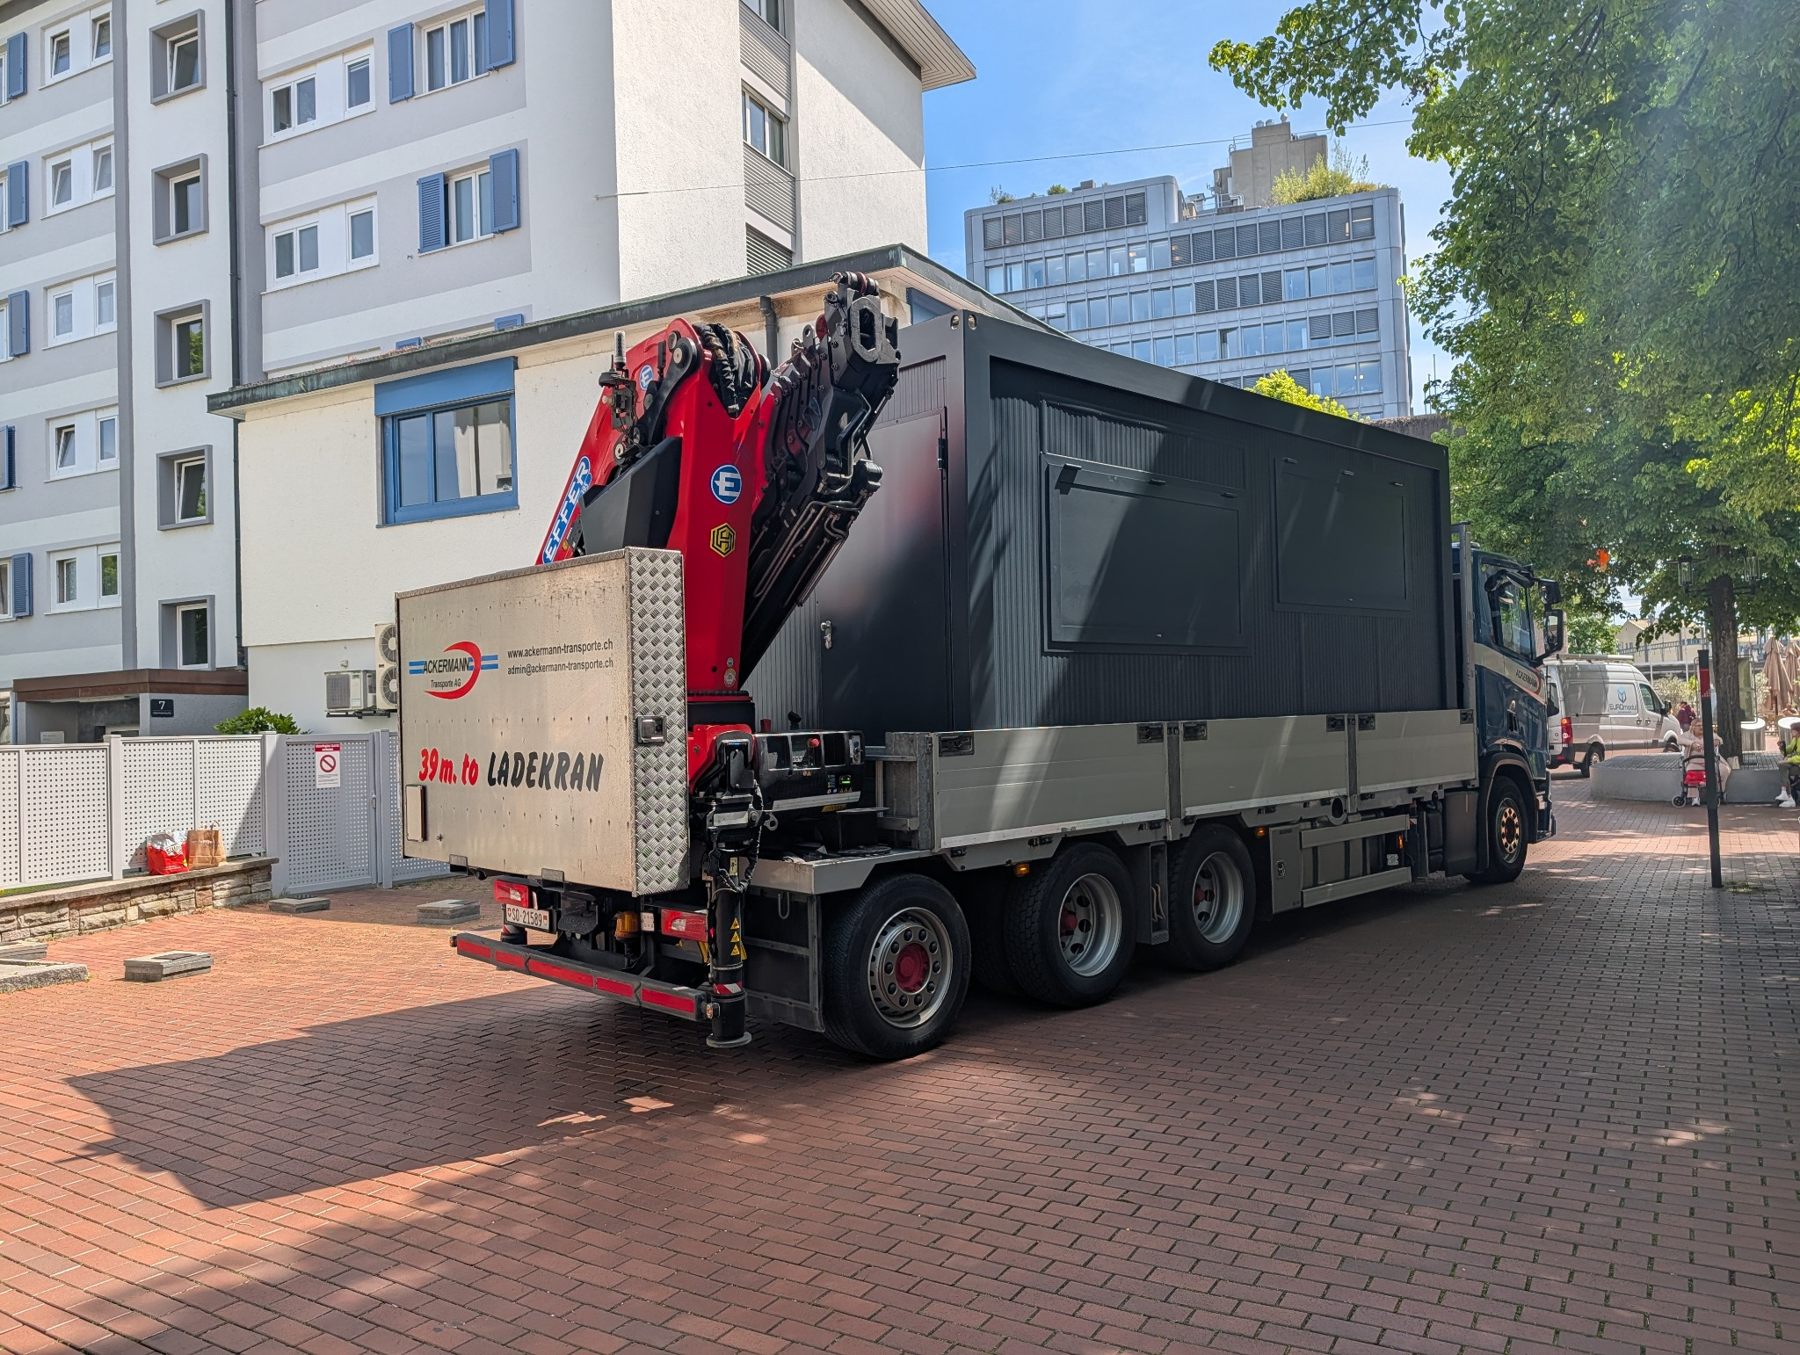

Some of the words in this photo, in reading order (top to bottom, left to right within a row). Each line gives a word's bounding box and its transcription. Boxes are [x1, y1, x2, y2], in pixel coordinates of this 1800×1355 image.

[714, 472, 741, 496] E
[545, 461, 588, 561] EFFER
[507, 639, 613, 658] www.ackermann-transporte.ch
[423, 657, 470, 673] ACKERMANN
[507, 657, 614, 676] admin@ackermann-transporte.ch
[431, 680, 453, 690] Transporte
[454, 678, 462, 687] AG
[158, 700, 166, 710] 7
[487, 751, 604, 792] LADEKRAN
